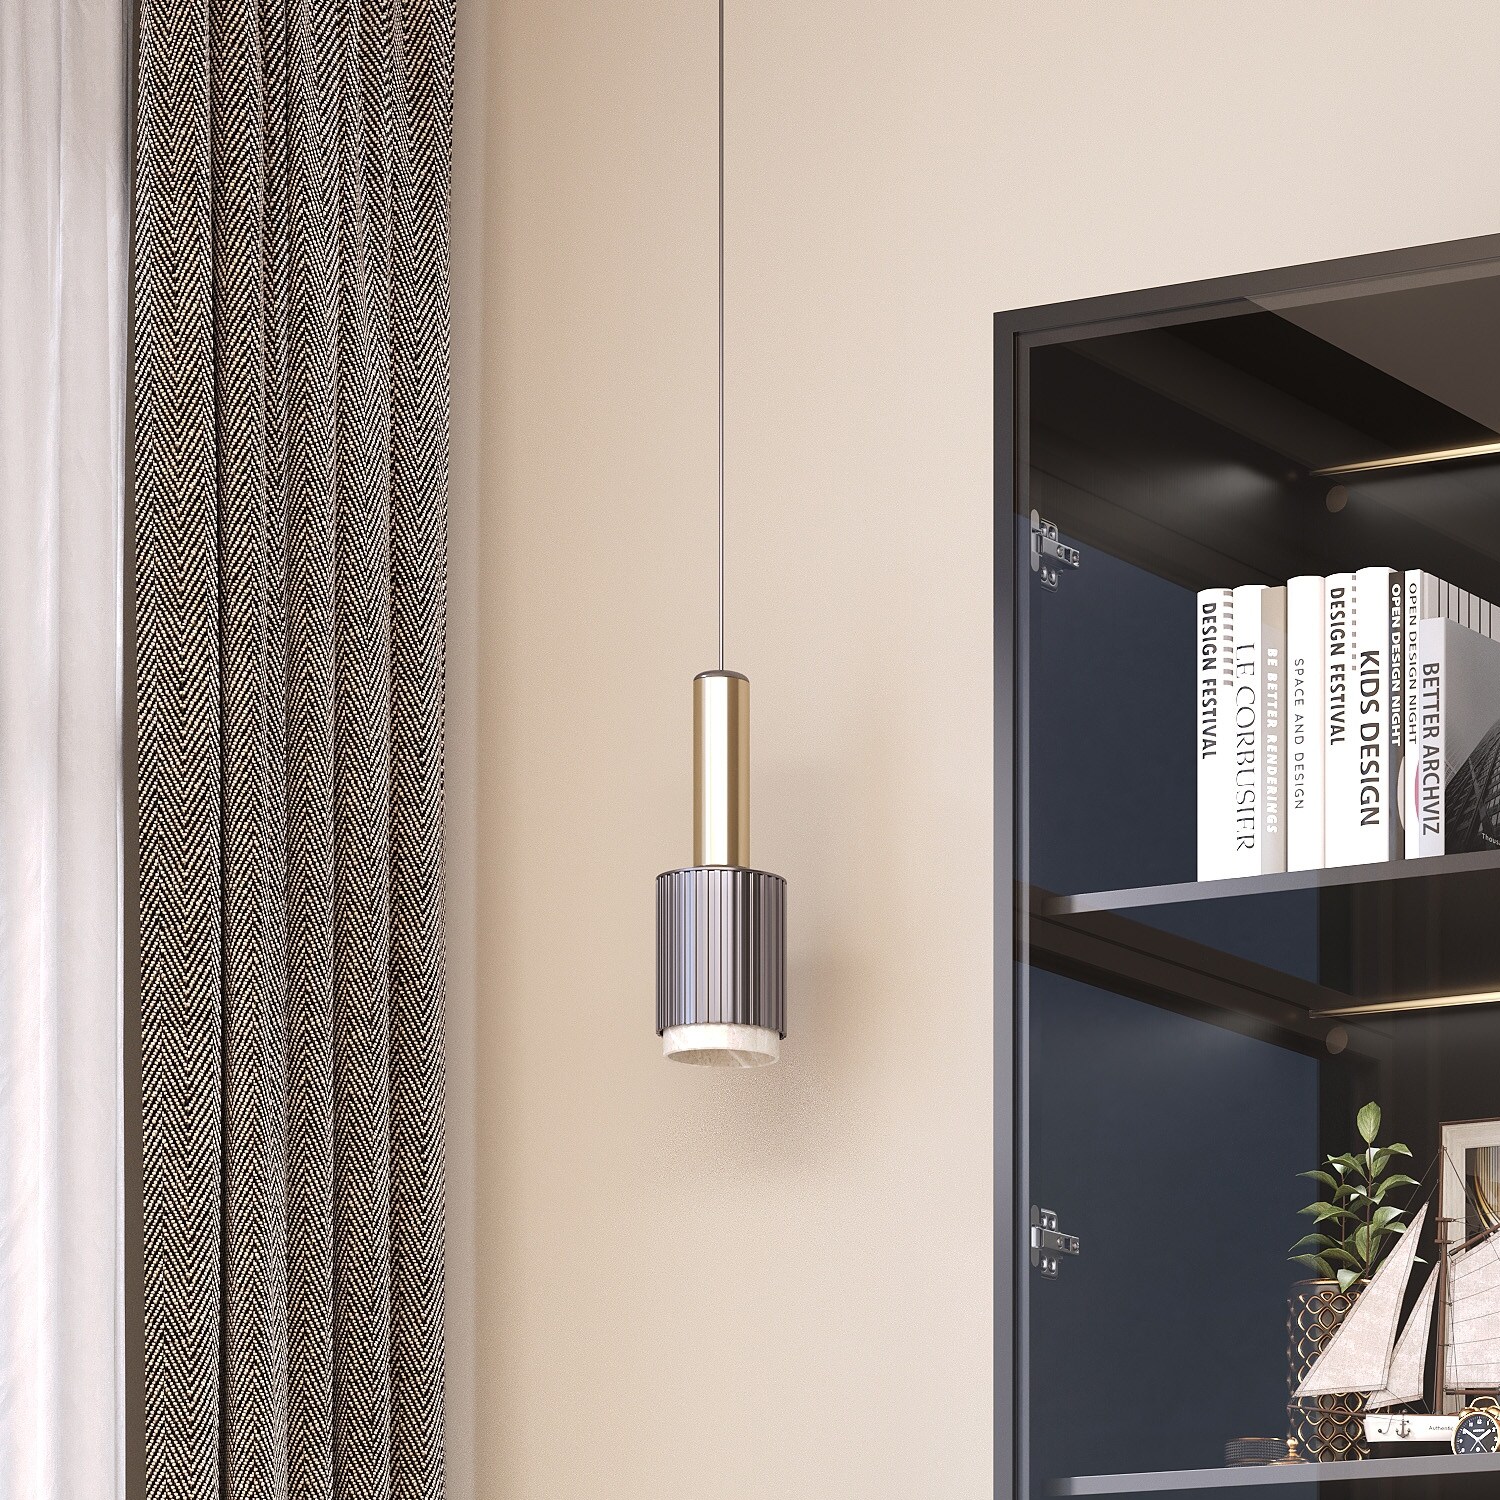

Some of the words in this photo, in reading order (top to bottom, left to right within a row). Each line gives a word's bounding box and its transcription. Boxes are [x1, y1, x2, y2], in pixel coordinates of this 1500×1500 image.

[1330, 587, 1345, 656] DESIGN
[1391, 583, 1401, 629] OPEN
[1409, 583, 1417, 627] OPEN
[1202, 602, 1217, 671] DESIGN
[1236, 643, 1255, 678] LE
[1267, 648, 1278, 666] BE
[1391, 631, 1401, 692] DESIGN
[1409, 633, 1417, 691] DESIGN
[1267, 670, 1278, 729] BETTER
[1294, 659, 1305, 709] SPACE
[1330, 664, 1345, 745] FESTIVAL
[1360, 650, 1380, 715] KIDS
[1423, 662, 1440, 739] BETTER
[1202, 680, 1217, 760] FESTIVAL
[1294, 714, 1305, 745] AND
[1391, 695, 1401, 746] NIGHT
[1409, 694, 1417, 744] NIGHT
[1236, 686, 1255, 851] CORBUSIER
[1267, 734, 1278, 833] RENDERINGS
[1294, 753, 1305, 810] DESIGN
[1360, 722, 1380, 826] DESIGN
[1423, 744, 1440, 836] ARCHVIZ
